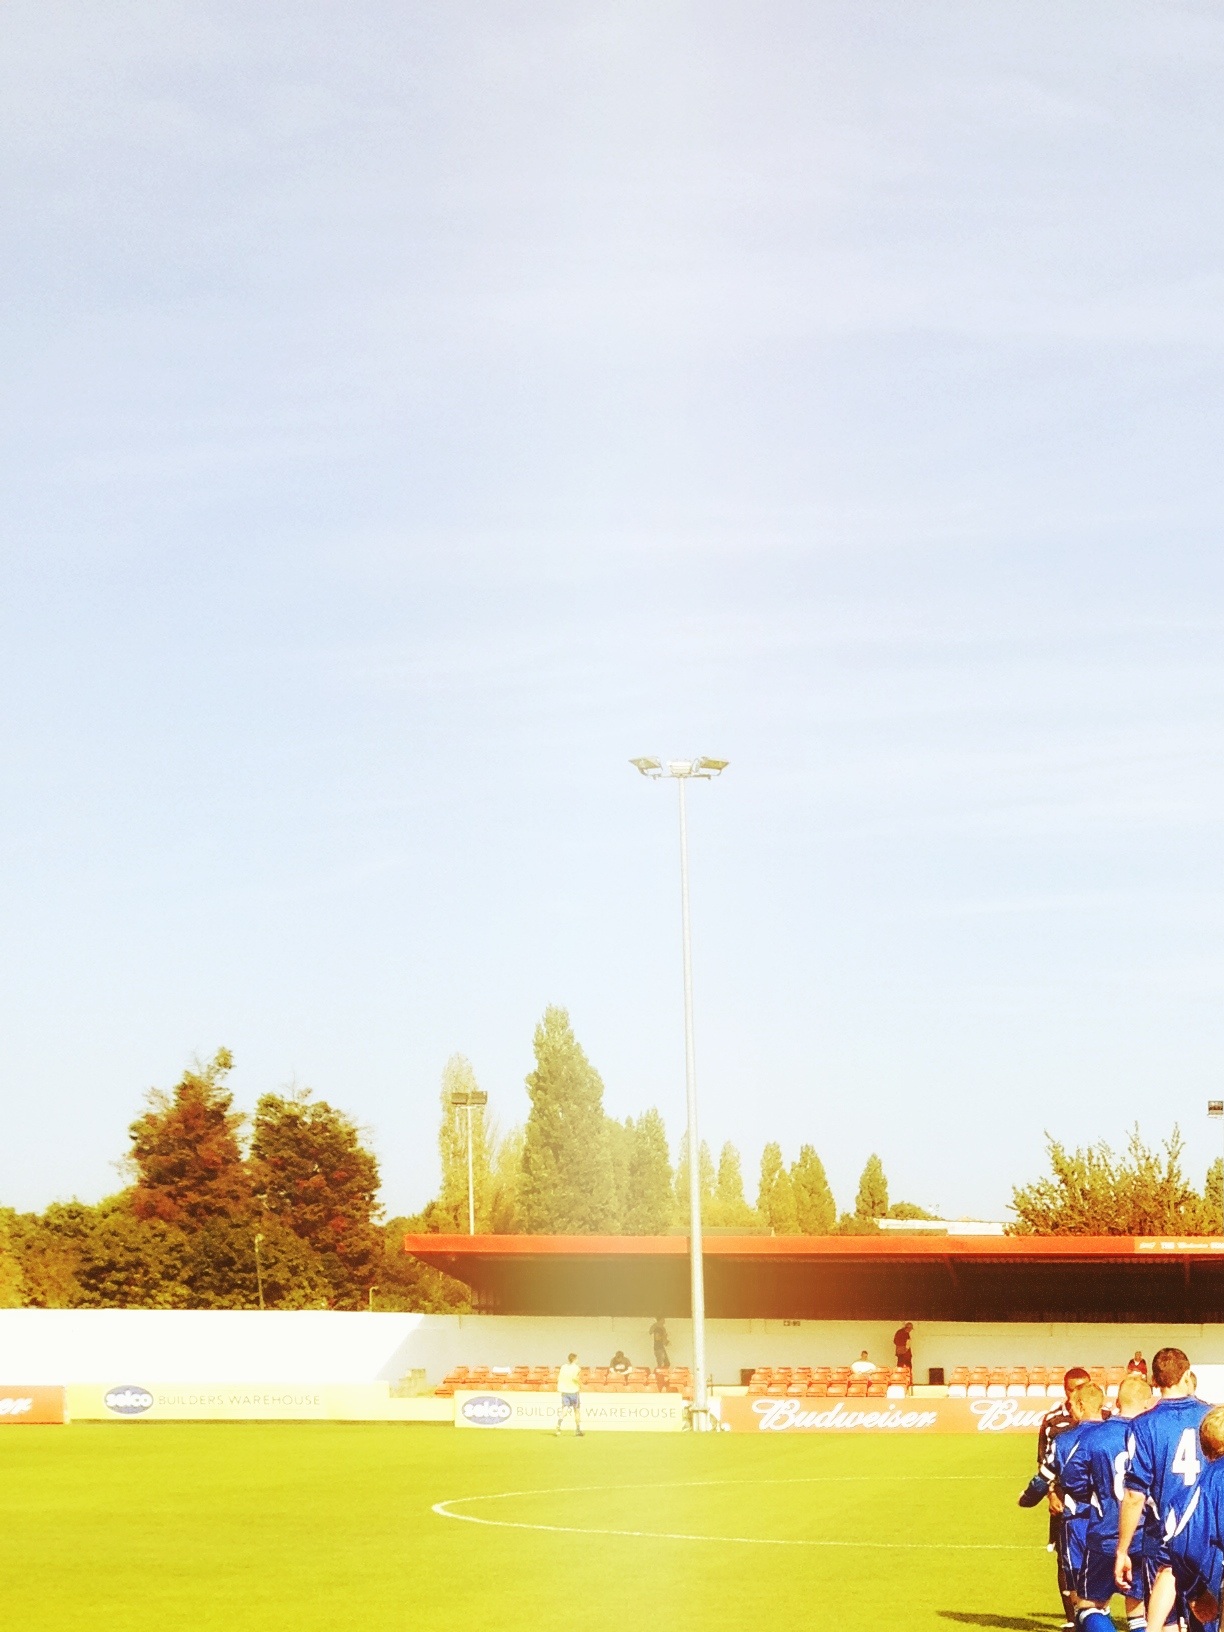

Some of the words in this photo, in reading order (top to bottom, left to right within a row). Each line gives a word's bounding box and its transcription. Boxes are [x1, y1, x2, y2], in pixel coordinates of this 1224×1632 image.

[158, 1395, 224, 1405] BUILDERS
[229, 1395, 321, 1405] WAREHOUSE
[516, 1406, 573, 1417] BUILDER
[585, 1407, 677, 1418] WAREHOUSE
[751, 1399, 938, 1431] Budweiser
[1171, 1427, 1201, 1486] 4
